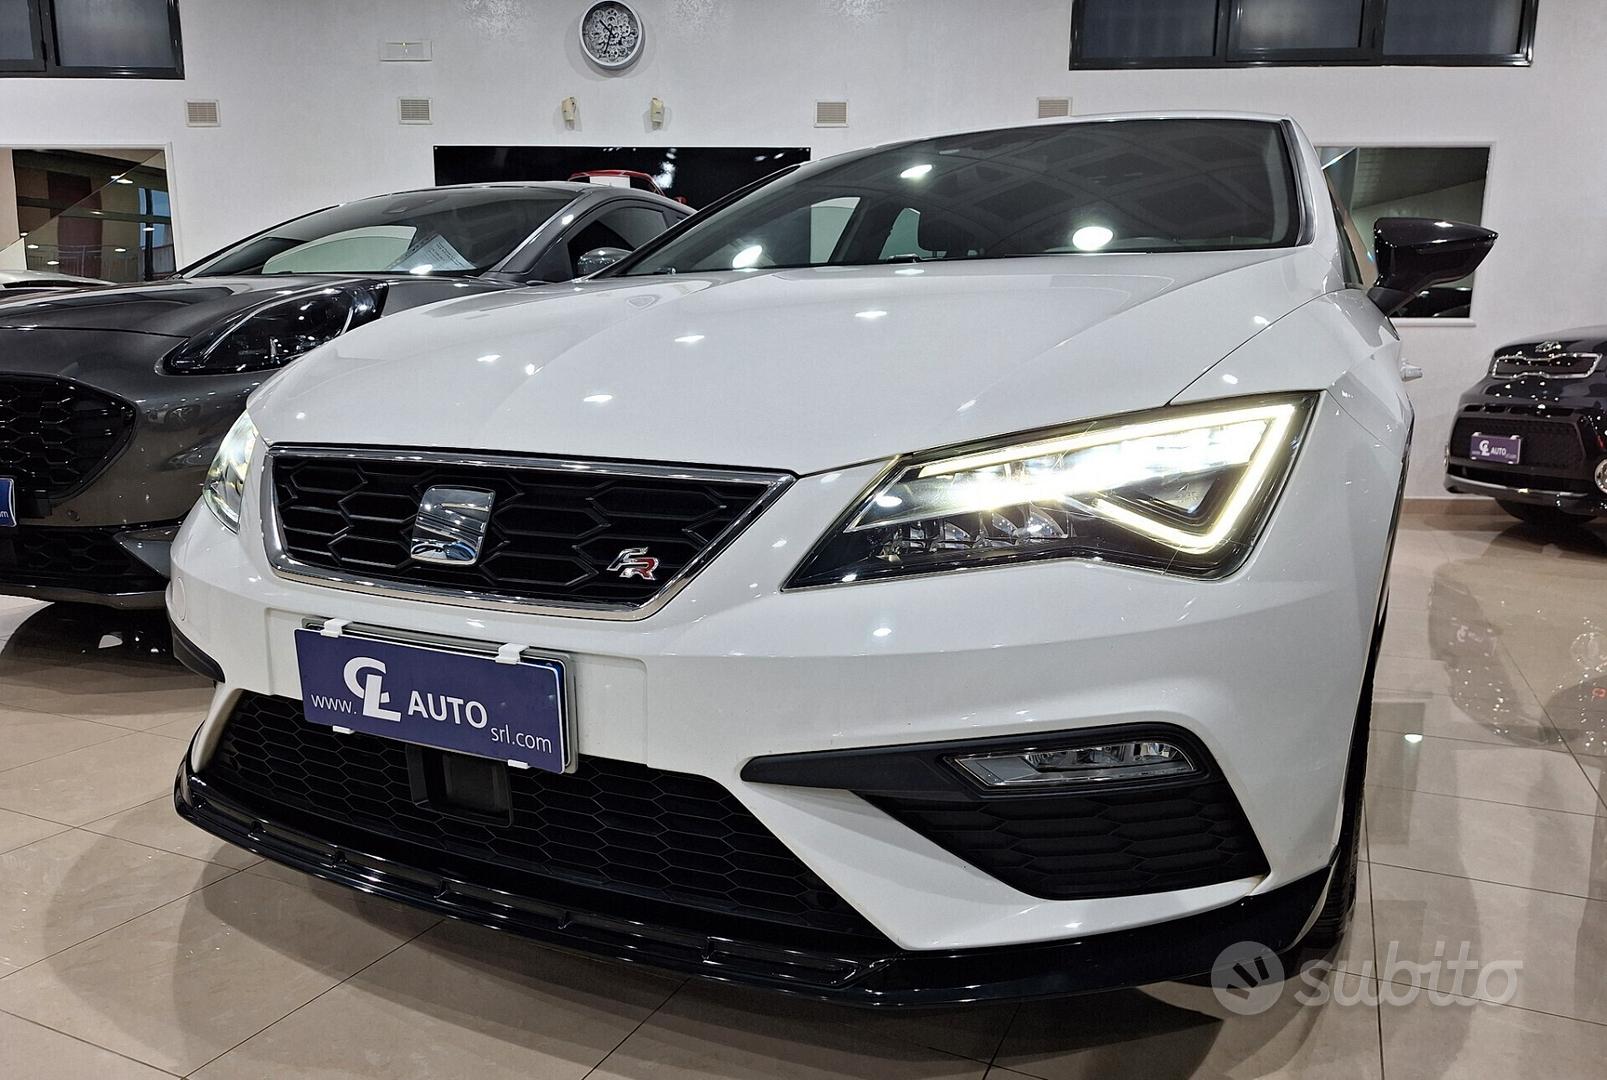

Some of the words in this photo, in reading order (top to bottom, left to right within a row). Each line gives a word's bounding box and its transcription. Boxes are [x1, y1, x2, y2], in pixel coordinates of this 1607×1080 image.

[1490, 447, 1507, 456] AUTO
[606, 546, 659, 581] FR
[310, 694, 357, 715] www.
[407, 690, 488, 729] AUTO
[490, 724, 552, 753] srl.com
